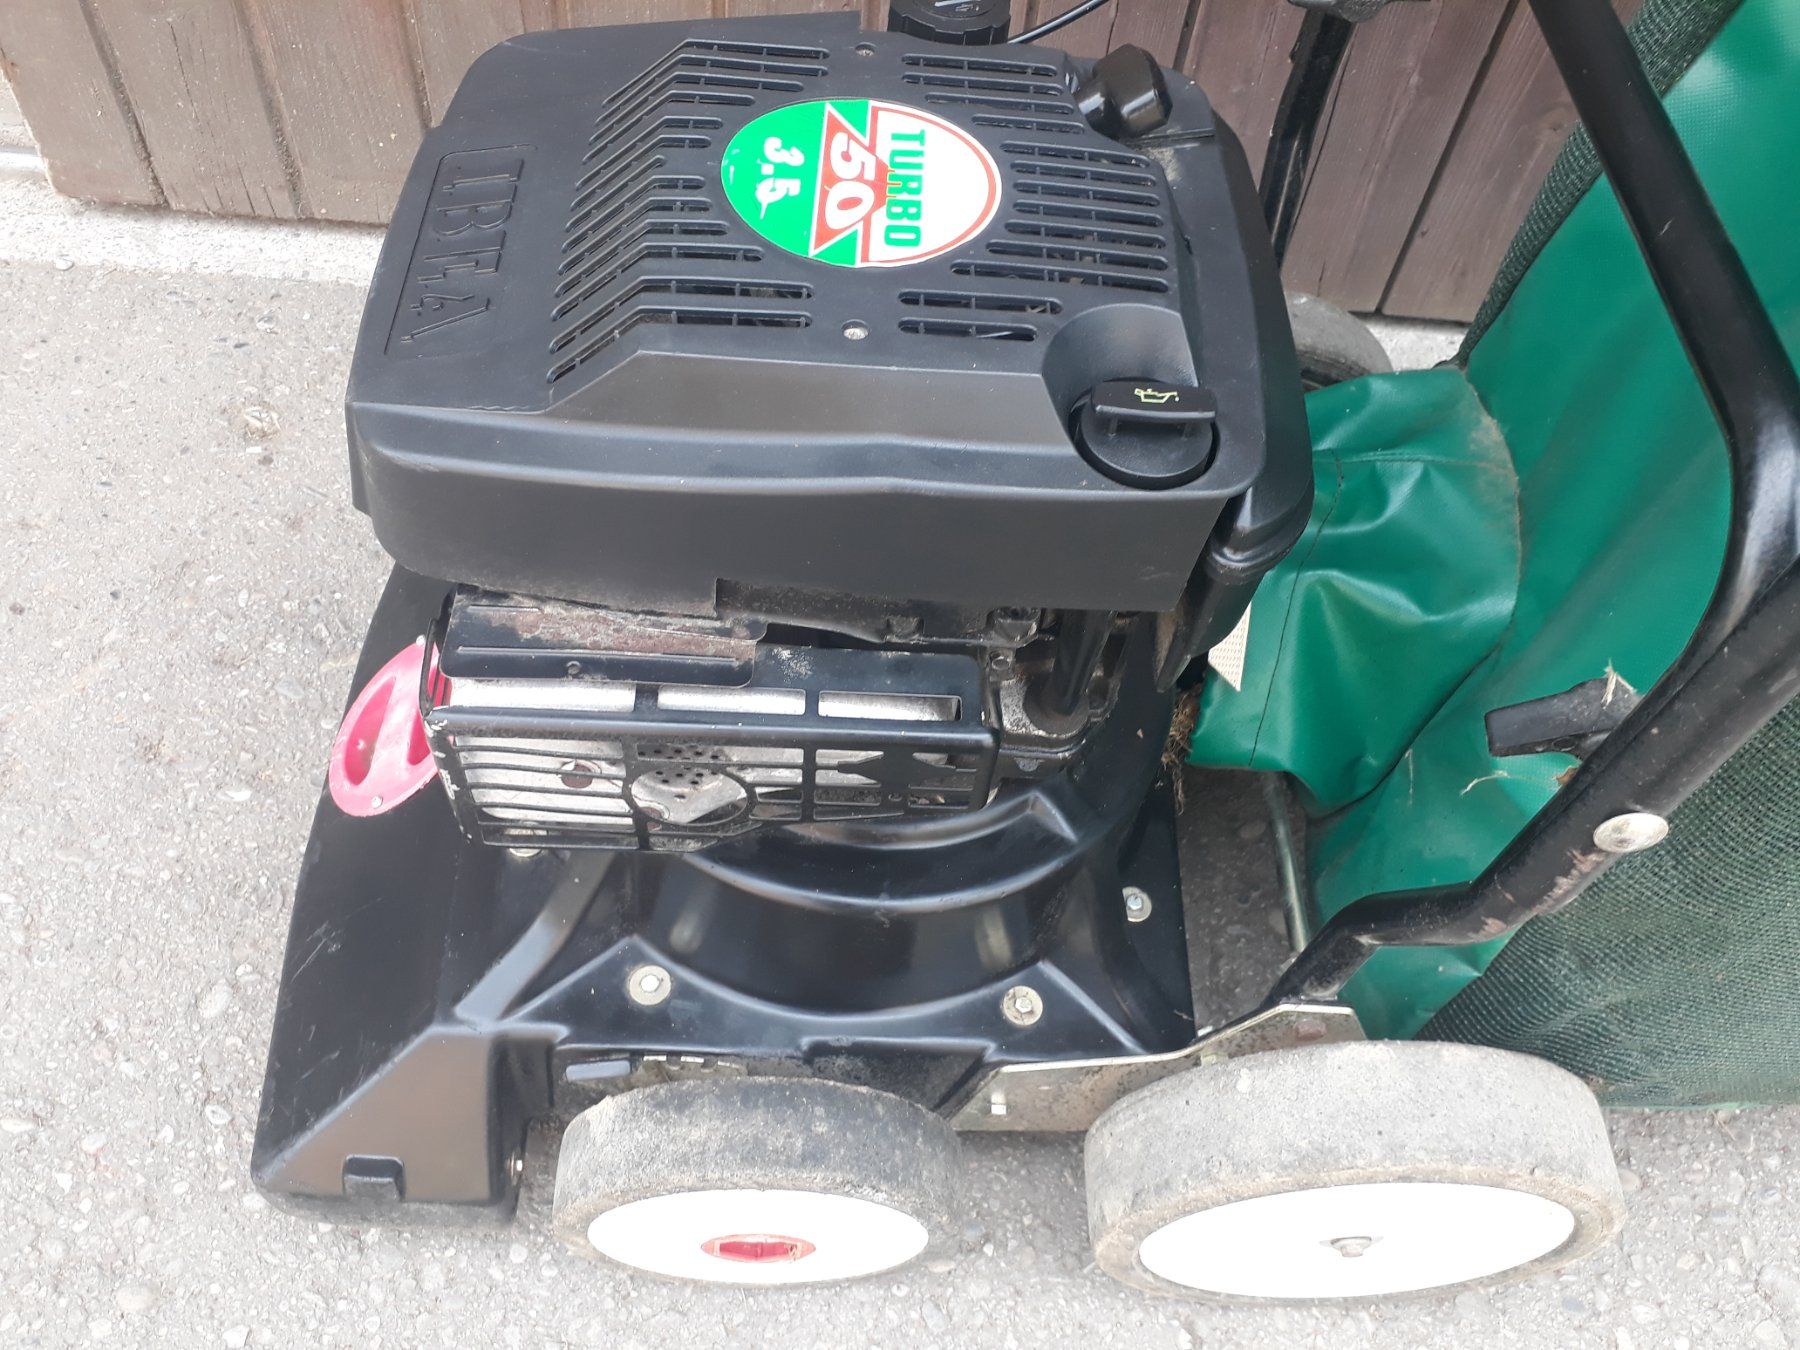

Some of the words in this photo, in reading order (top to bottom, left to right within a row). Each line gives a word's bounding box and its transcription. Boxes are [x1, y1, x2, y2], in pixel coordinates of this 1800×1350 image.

[755, 136, 806, 206] 3.5
[824, 132, 877, 230] 50
[883, 129, 926, 247] TURBO
[400, 158, 525, 343] IBEA
